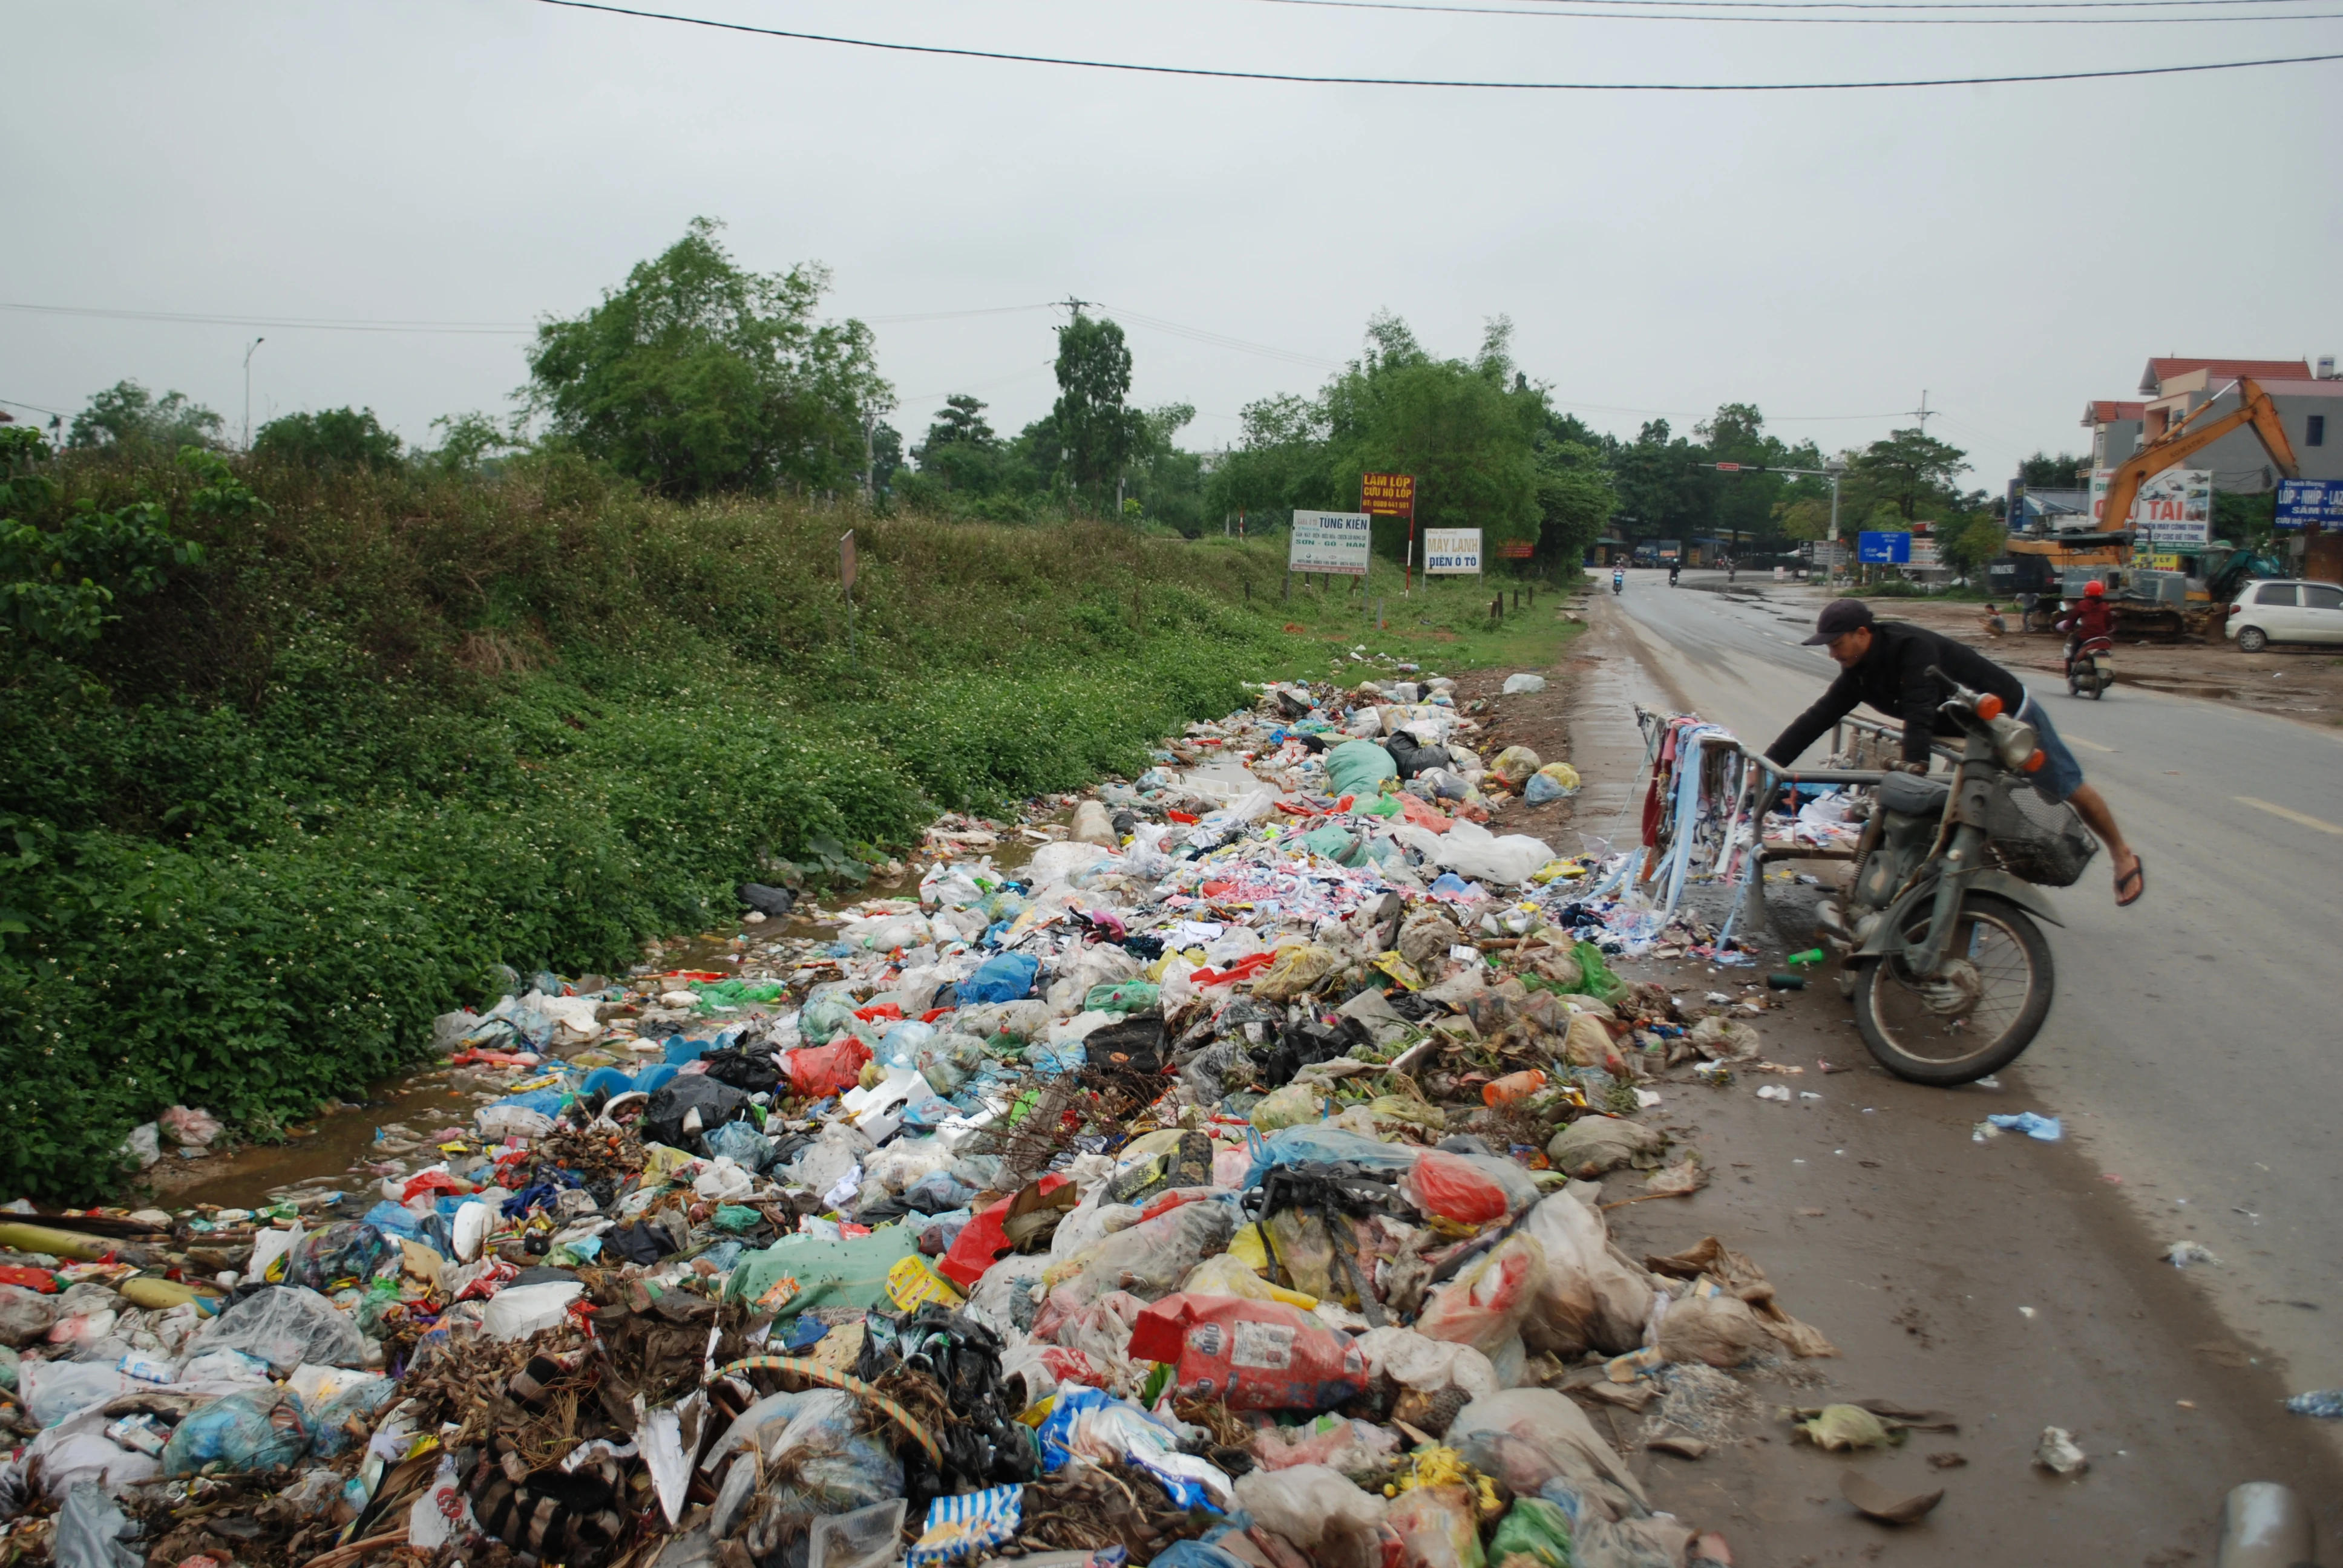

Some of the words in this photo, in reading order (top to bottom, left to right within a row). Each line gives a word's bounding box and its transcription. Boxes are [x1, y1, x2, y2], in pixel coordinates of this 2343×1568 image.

[1390, 475, 1411, 488] LỐP
[2278, 486, 2295, 505] LỐP
[1319, 515, 1343, 529] TÙNG
[1345, 517, 1368, 530] KIÊN
[1202, 1322, 1220, 1355] OMO
